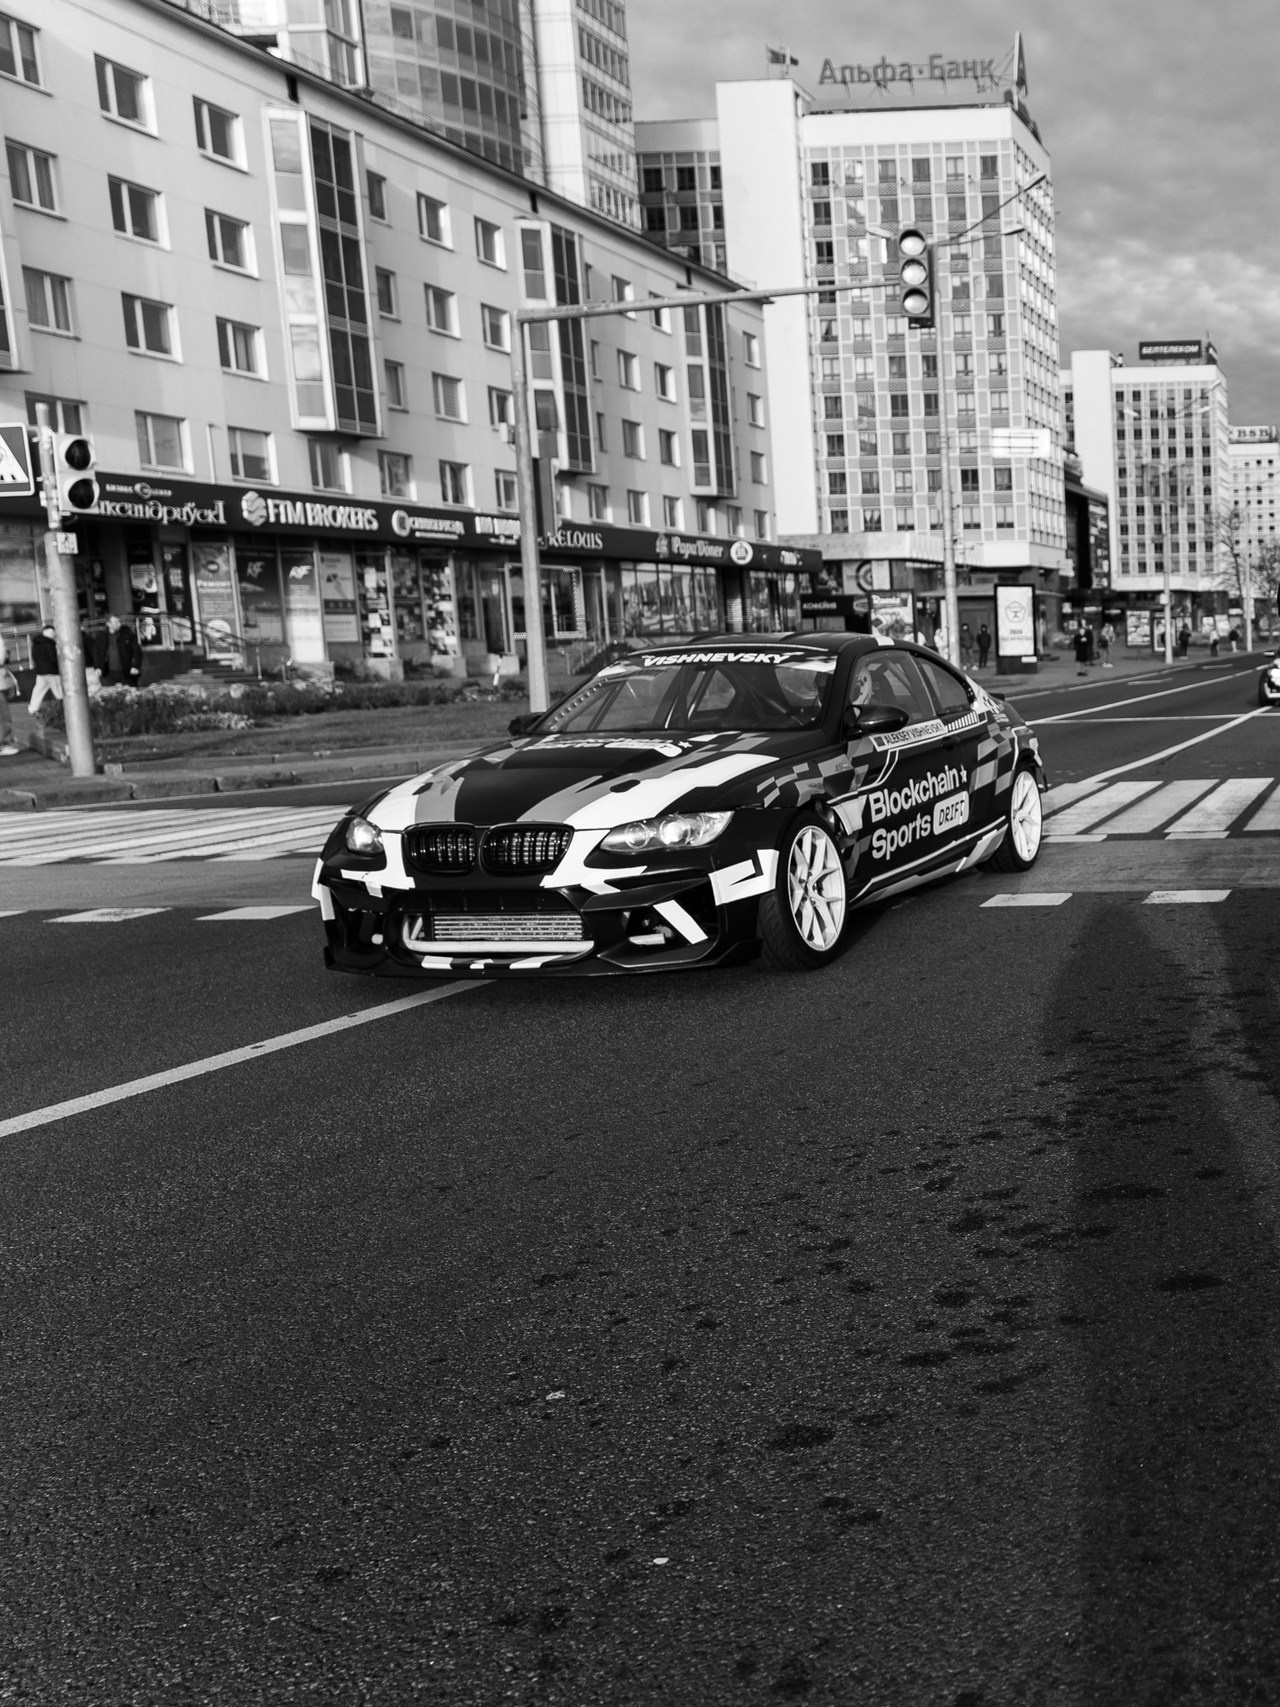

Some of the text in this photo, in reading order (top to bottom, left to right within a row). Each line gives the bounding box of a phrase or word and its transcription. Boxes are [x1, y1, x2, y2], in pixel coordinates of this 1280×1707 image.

[305, 502, 379, 531] BROKERS
[642, 653, 790, 667] VISHNEVSKY
[884, 723, 944, 745] ALEKSEY VISHNEVSKY
[868, 764, 960, 823] Blockchain
[872, 800, 966, 860] Sports DRIFT
